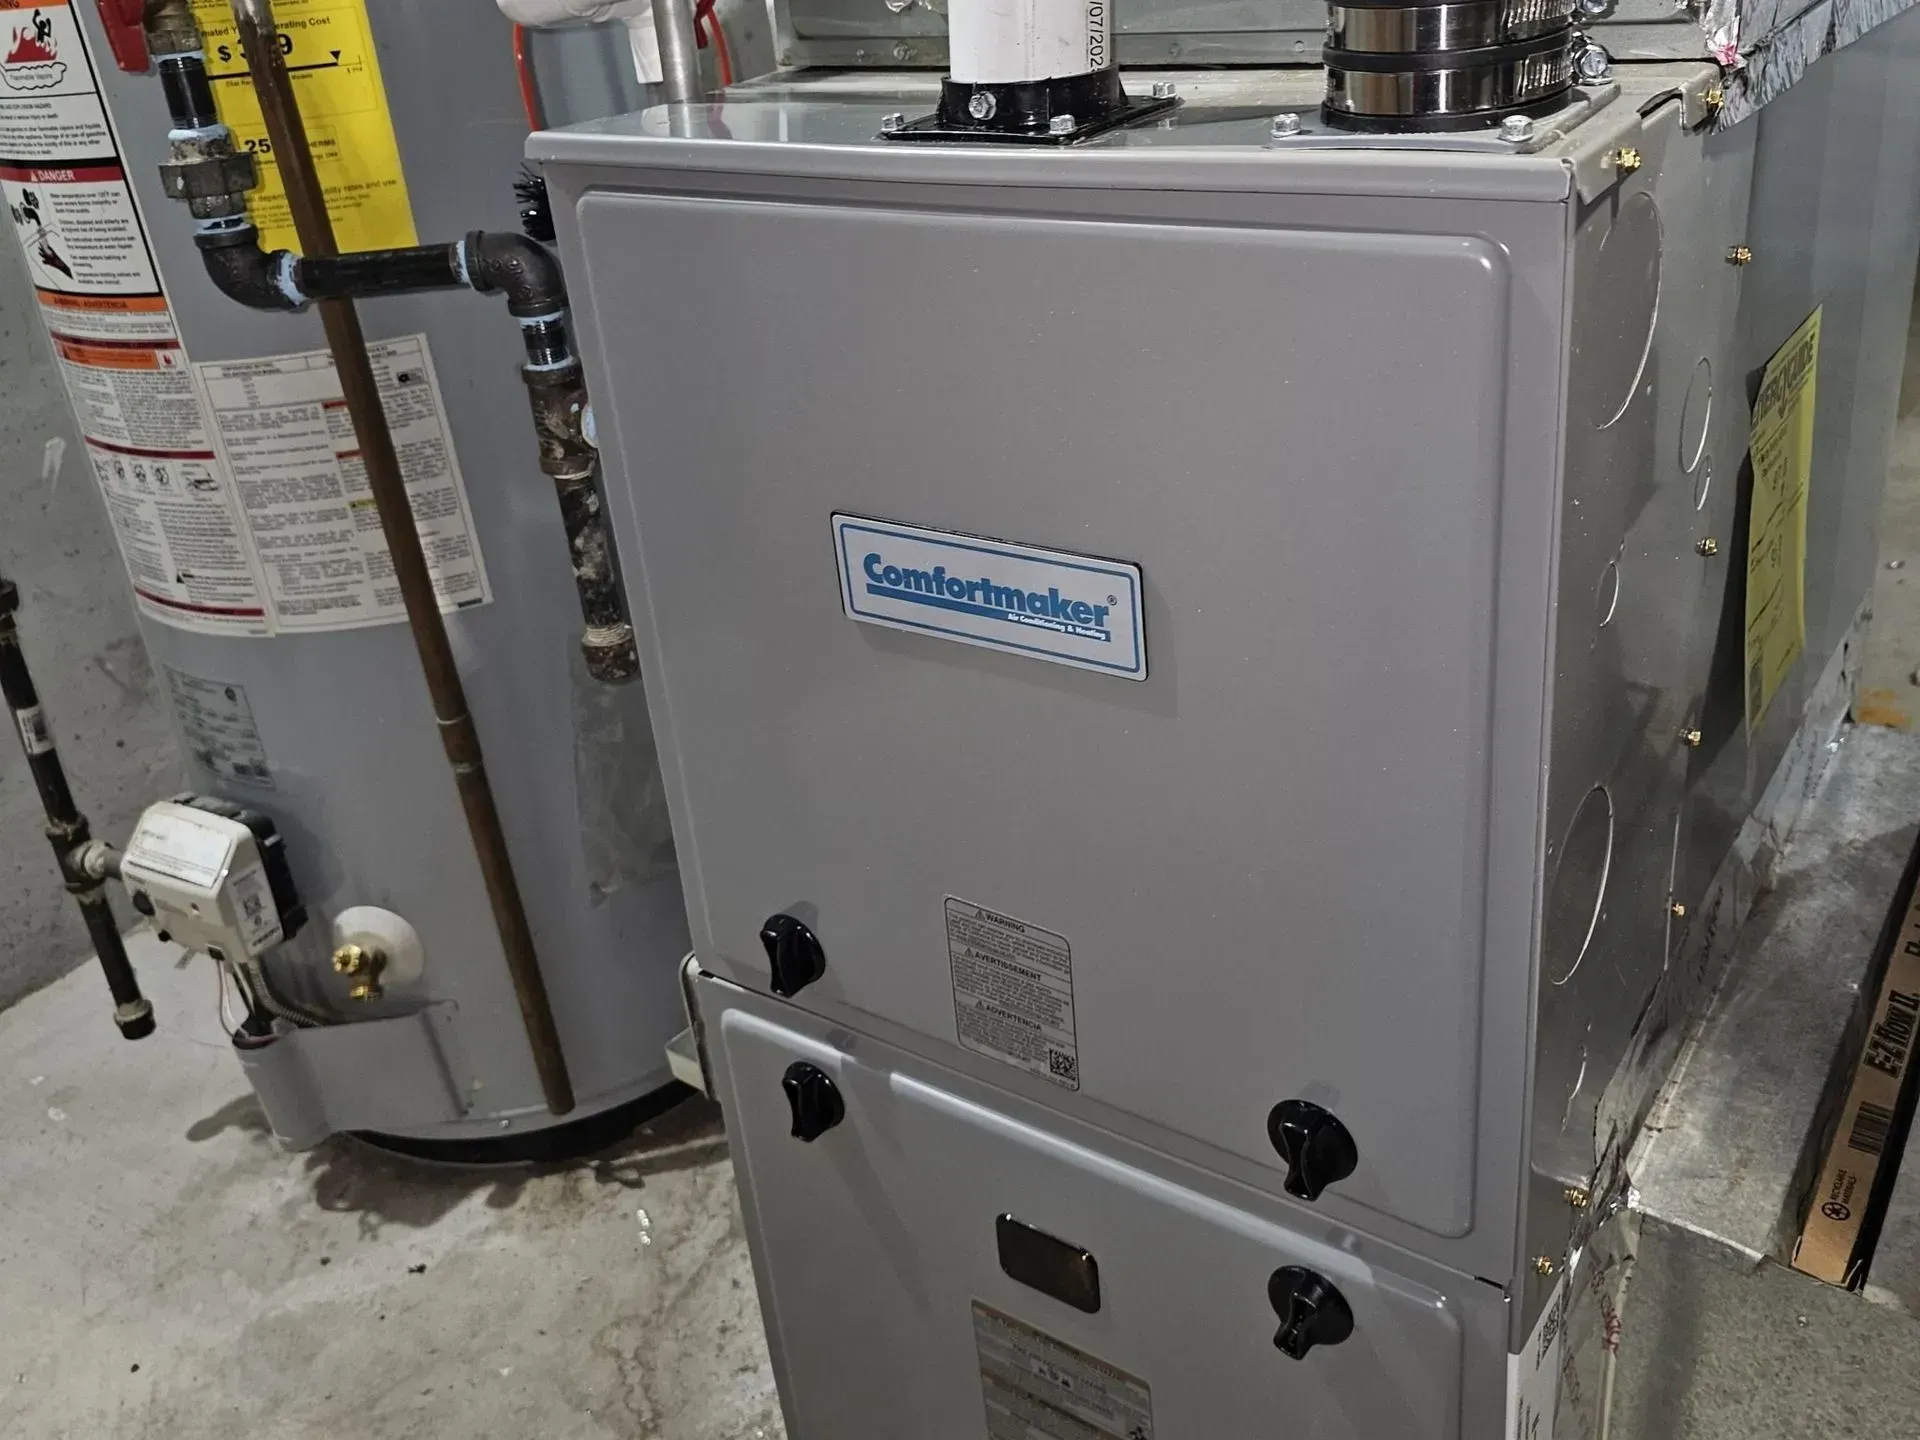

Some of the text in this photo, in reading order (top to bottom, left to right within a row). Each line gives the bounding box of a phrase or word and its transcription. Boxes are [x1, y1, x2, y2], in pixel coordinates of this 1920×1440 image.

[309, 16, 331, 26] Cost
[1089, 1, 1104, 73] /07/202
[217, 44, 232, 63] $
[309, 139, 336, 149] HERMS
[38, 168, 76, 181] DANGER
[863, 552, 1110, 628] Comfortmaker
[1007, 612, 1107, 641] Air Conditioning & Heating
[985, 912, 1026, 934] WARNING
[975, 950, 1041, 982] AVERTISSEMENT
[986, 1003, 1042, 1031] ADVERTENCIA
